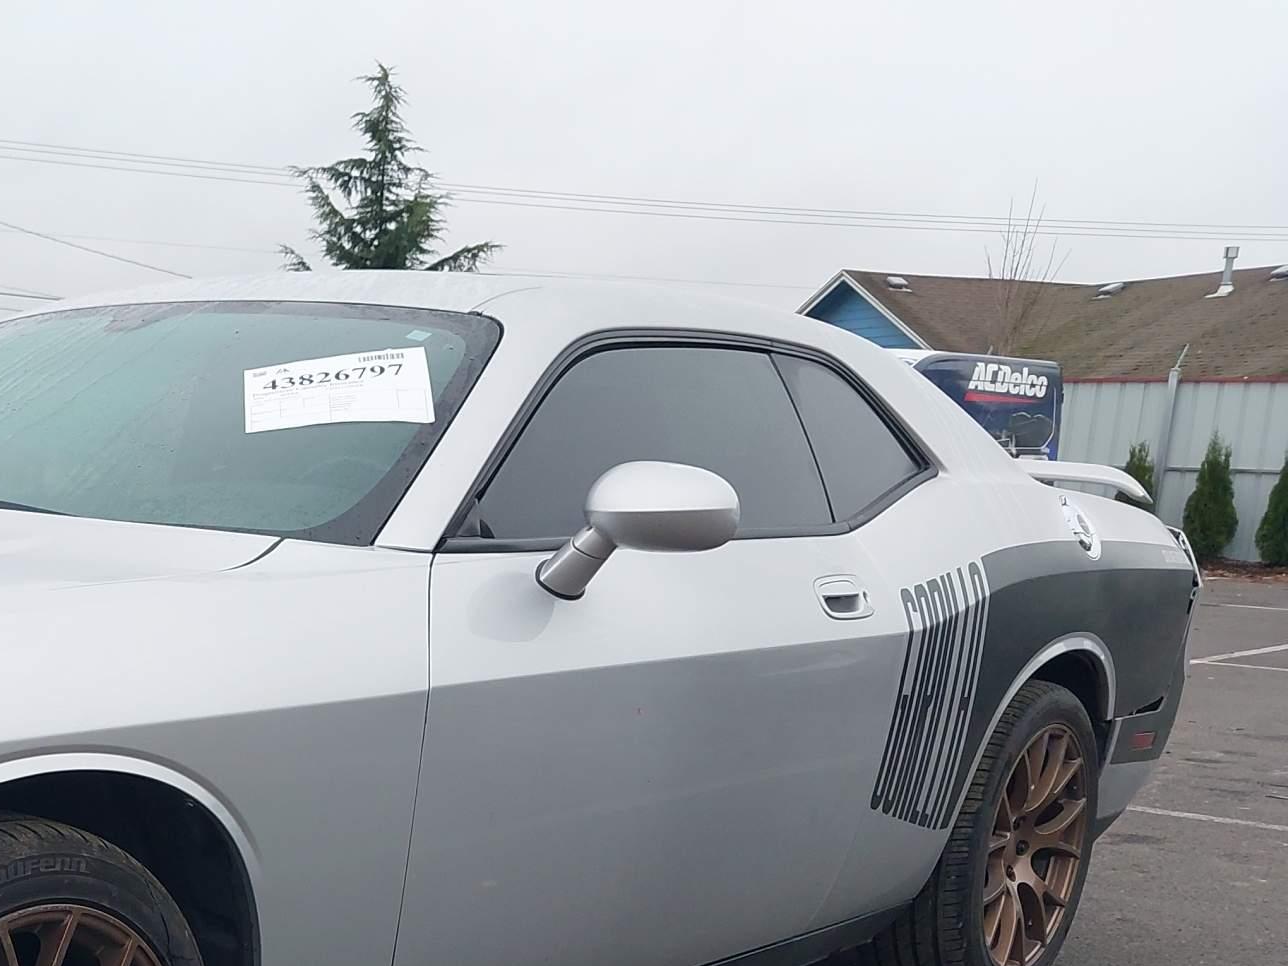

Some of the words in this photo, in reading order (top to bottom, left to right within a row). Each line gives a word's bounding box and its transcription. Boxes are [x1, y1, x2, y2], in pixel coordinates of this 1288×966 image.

[263, 363, 403, 390] 43826797
[968, 362, 1048, 398] ACDelco
[870, 560, 990, 830] GORILLA
